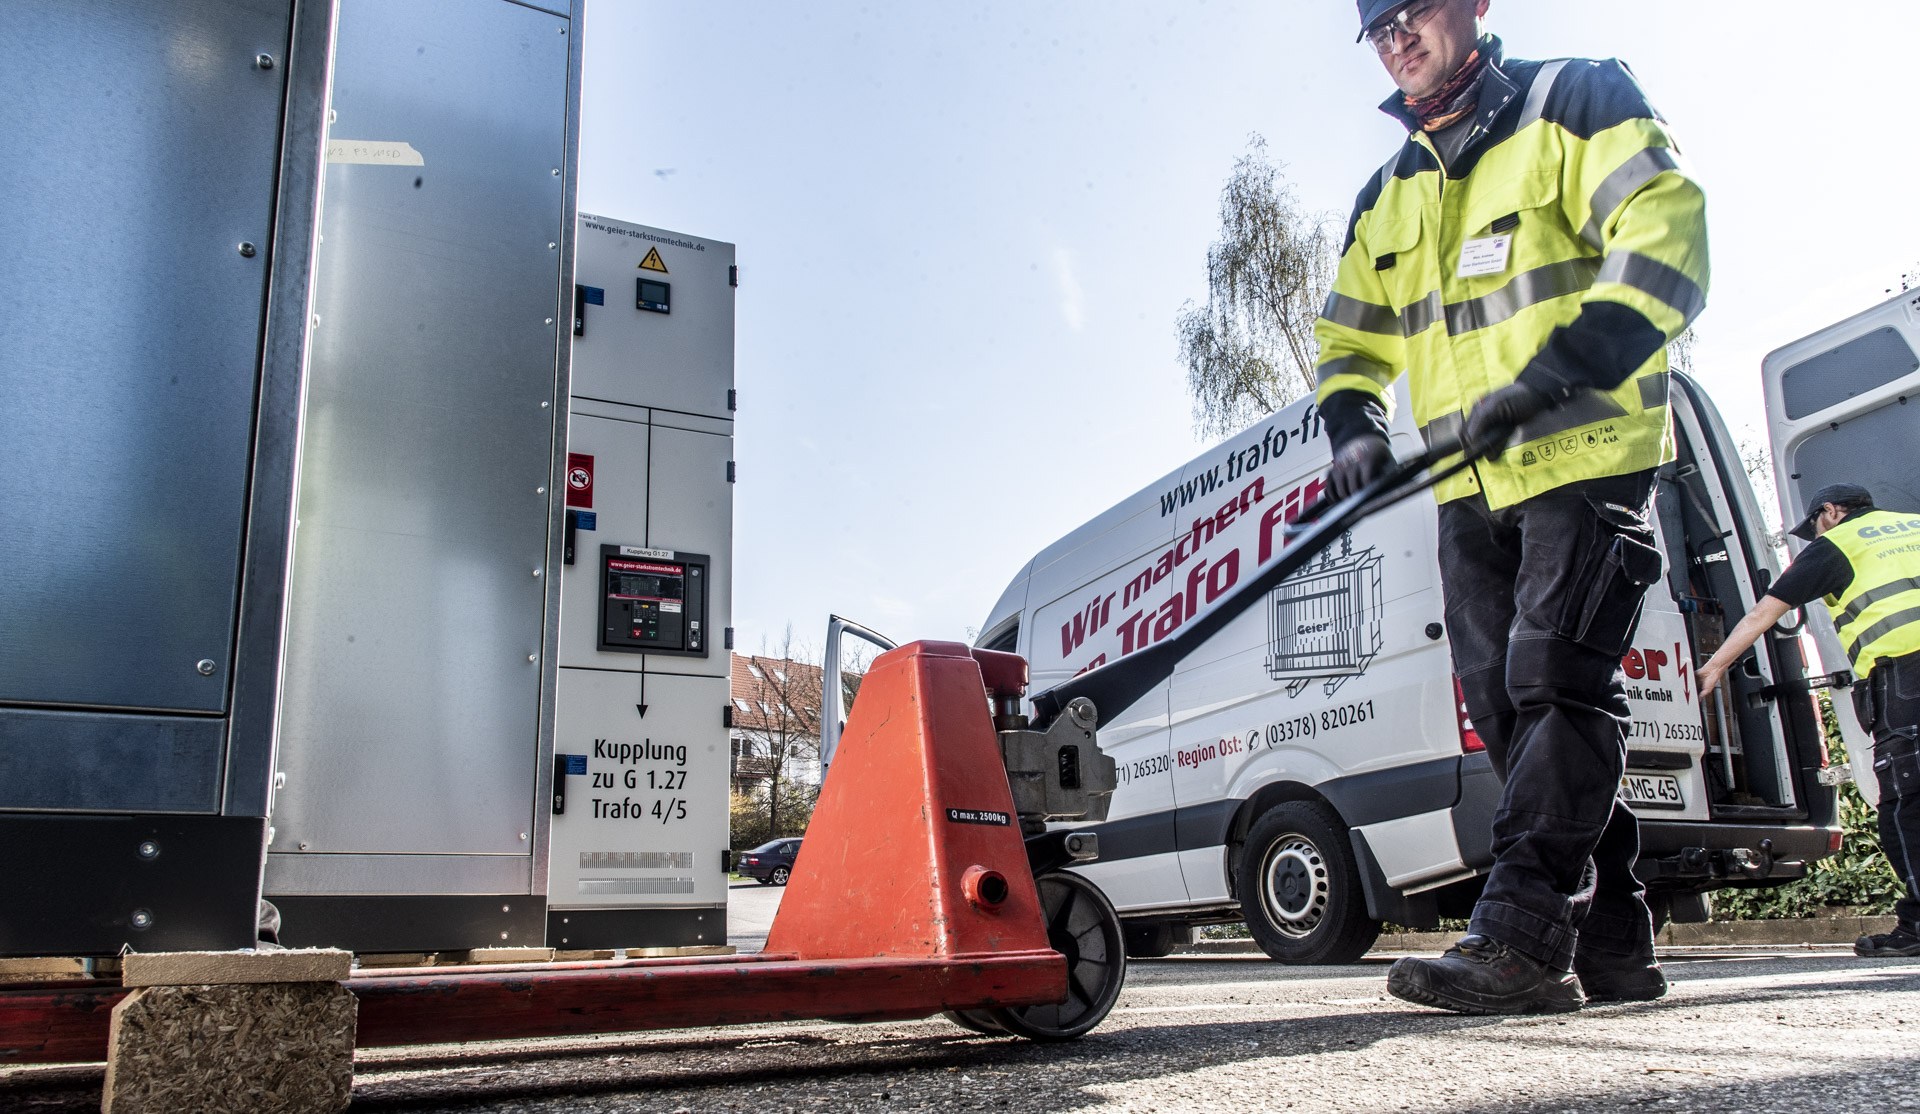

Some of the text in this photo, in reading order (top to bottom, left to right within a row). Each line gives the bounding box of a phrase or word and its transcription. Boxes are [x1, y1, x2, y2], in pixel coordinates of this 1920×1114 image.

[585, 221, 705, 252] www.geier-starkstromtechnik.de
[1604, 425, 1615, 433] kA
[1609, 435, 1619, 443] kA
[627, 548, 652, 556] Kupplung
[610, 561, 682, 573] www.geier-starkstromtechnik.de
[1061, 475, 1265, 659] Wir machen
[1116, 547, 1240, 656] Trafo
[1297, 622, 1330, 635] Geier
[1621, 647, 1668, 681] er
[1645, 688, 1673, 702] GmbH
[1134, 754, 1169, 779] 265320
[1177, 744, 1216, 769] Region
[1219, 736, 1243, 757] Ost:
[1265, 712, 1317, 750] (03378)
[1321, 700, 1375, 731] 820261
[1664, 723, 1704, 741] 265320
[594, 738, 687, 766] Kupplung
[592, 769, 687, 790] zu G 1.27
[1629, 777, 1679, 801] MG 45
[592, 797, 687, 825] Trafo 4/5
[951, 809, 1007, 824] Q max. 2500kg
